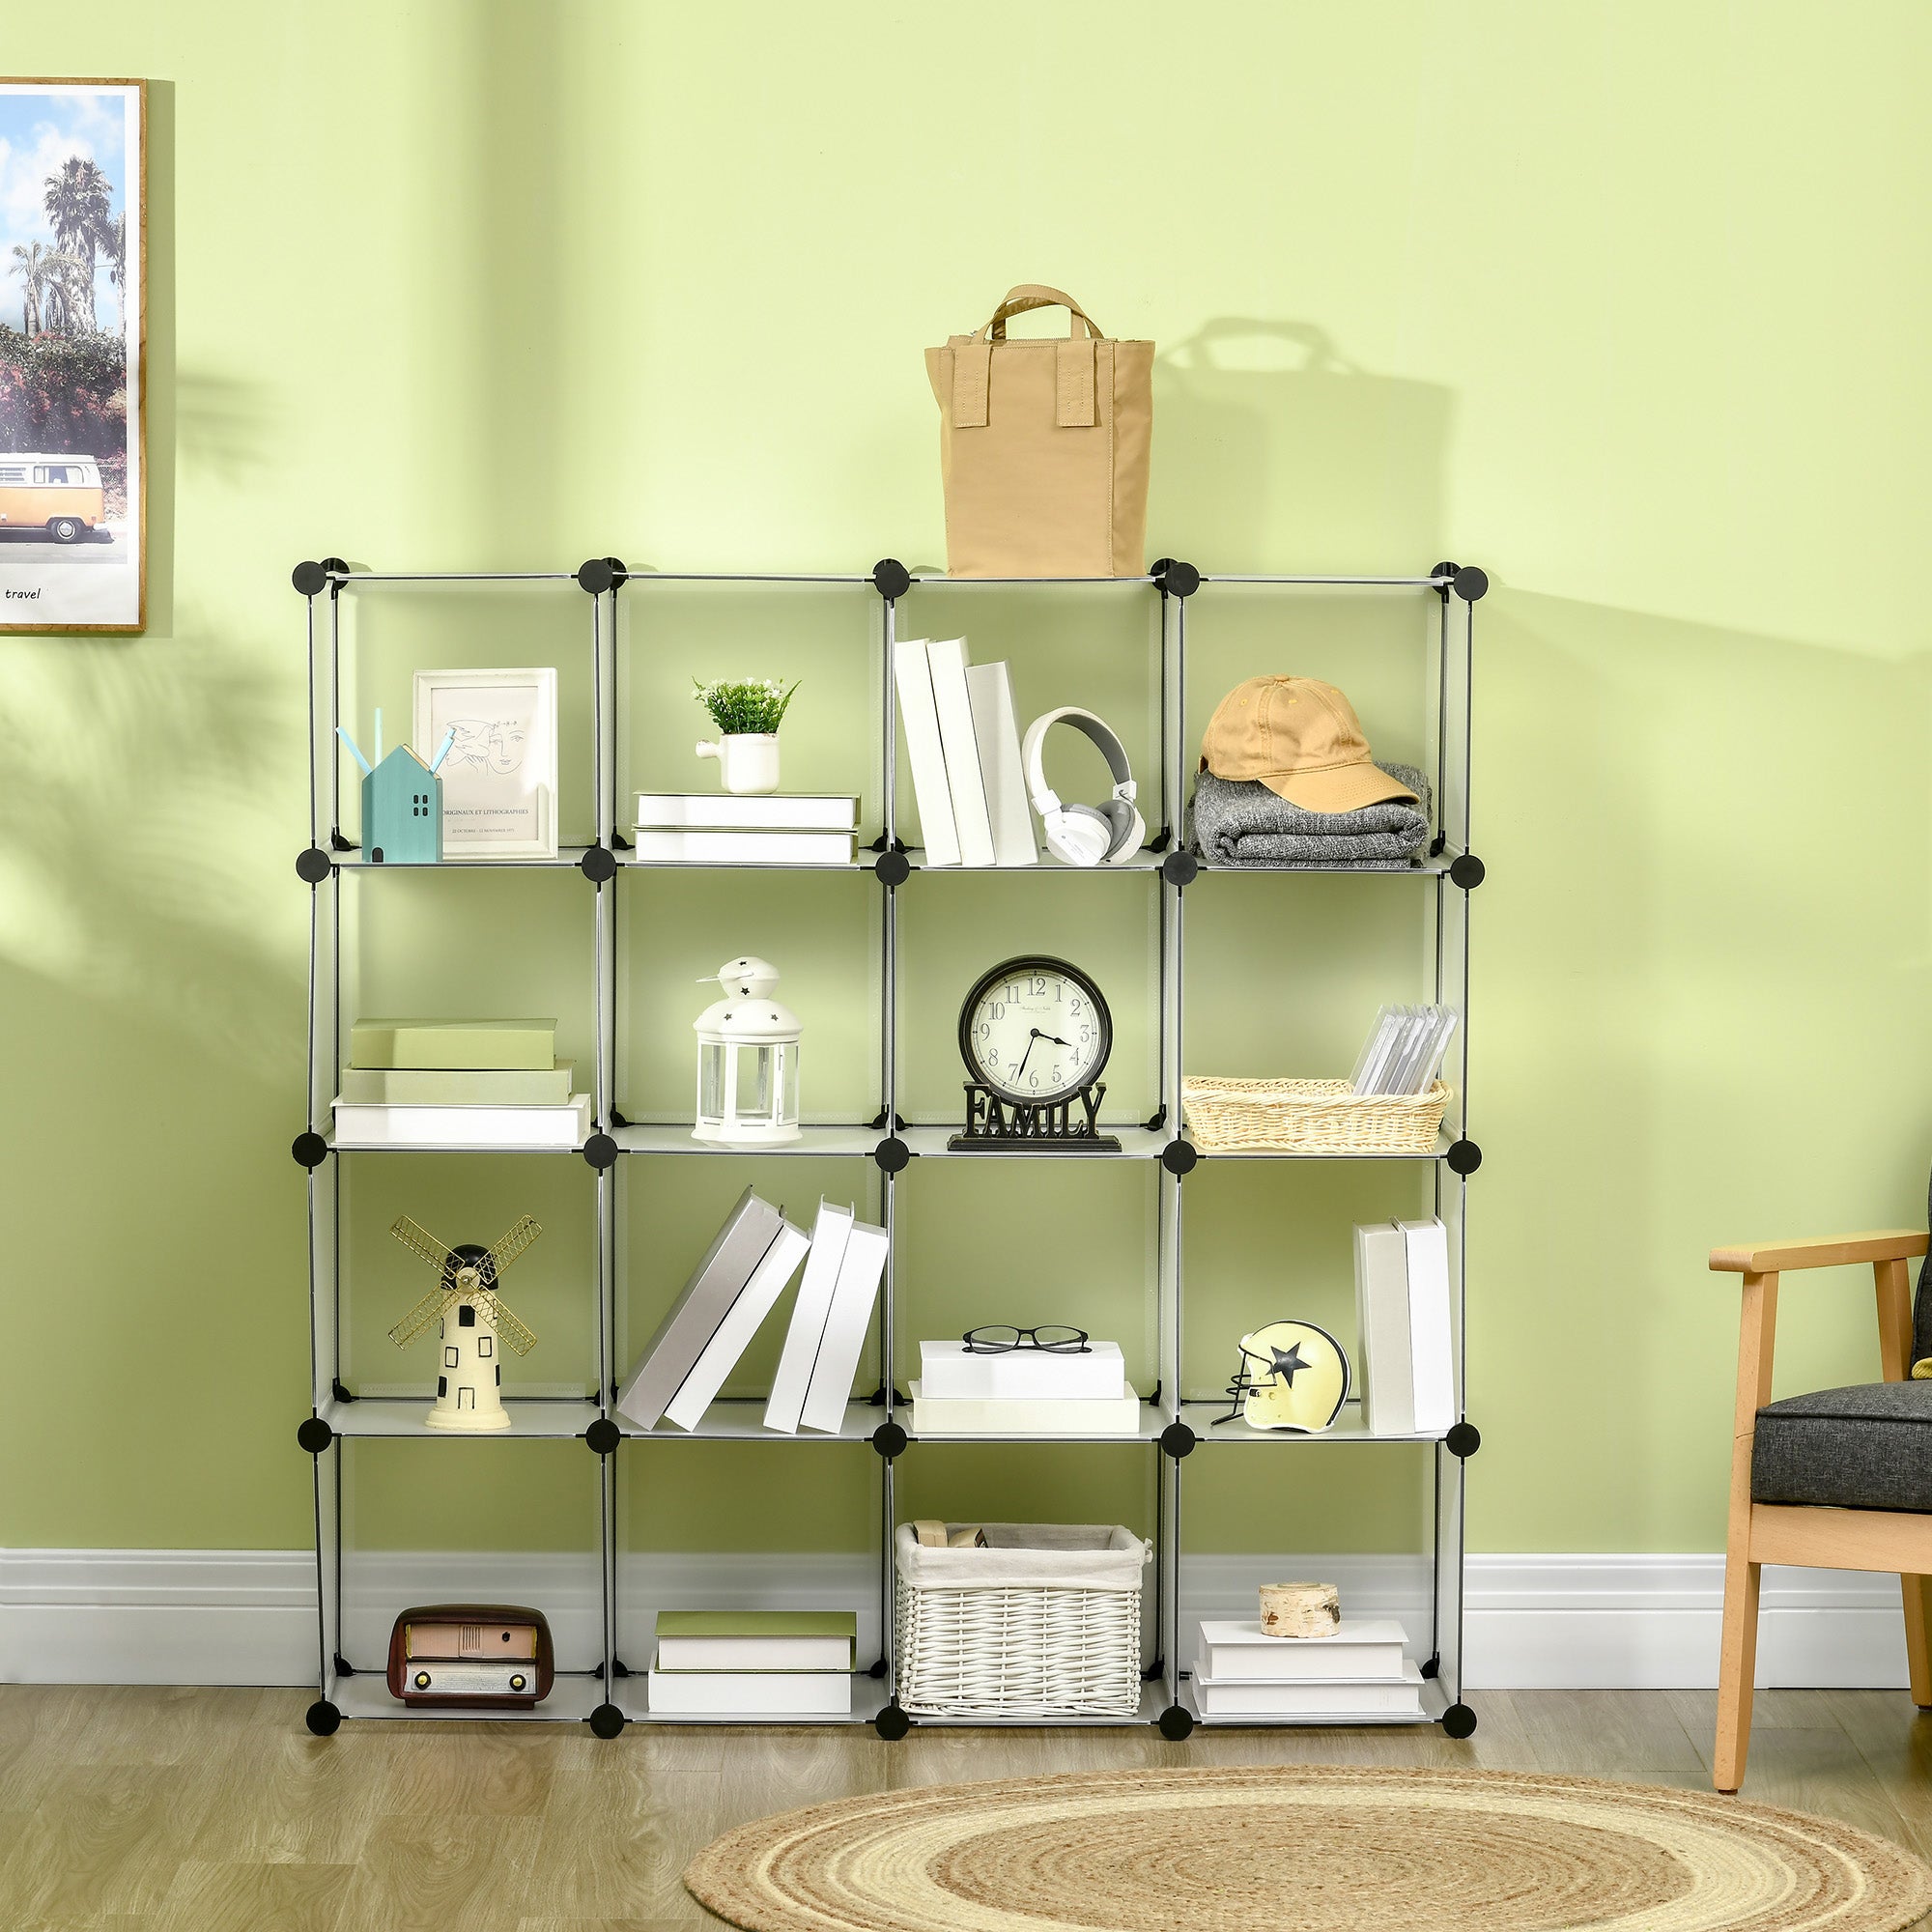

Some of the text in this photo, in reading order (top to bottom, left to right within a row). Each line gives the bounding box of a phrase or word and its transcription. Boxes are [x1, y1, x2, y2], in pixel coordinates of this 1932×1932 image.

[5, 587, 42, 599] travel
[1005, 985, 1021, 1004] 11
[1027, 978, 1046, 996] 12
[1055, 984, 1063, 1003] 1
[988, 1002, 1006, 1020] 10
[1070, 999, 1081, 1017] 2
[980, 1023, 990, 1041] 9
[1080, 1024, 1090, 1042] 3
[988, 1048, 999, 1066] 8
[1069, 1047, 1080, 1065] 4
[1008, 1064, 1019, 1082] 7
[1029, 1069, 1038, 1088] 6
[1051, 1065, 1062, 1083] 5
[963, 1081, 1107, 1139] FAMILY
